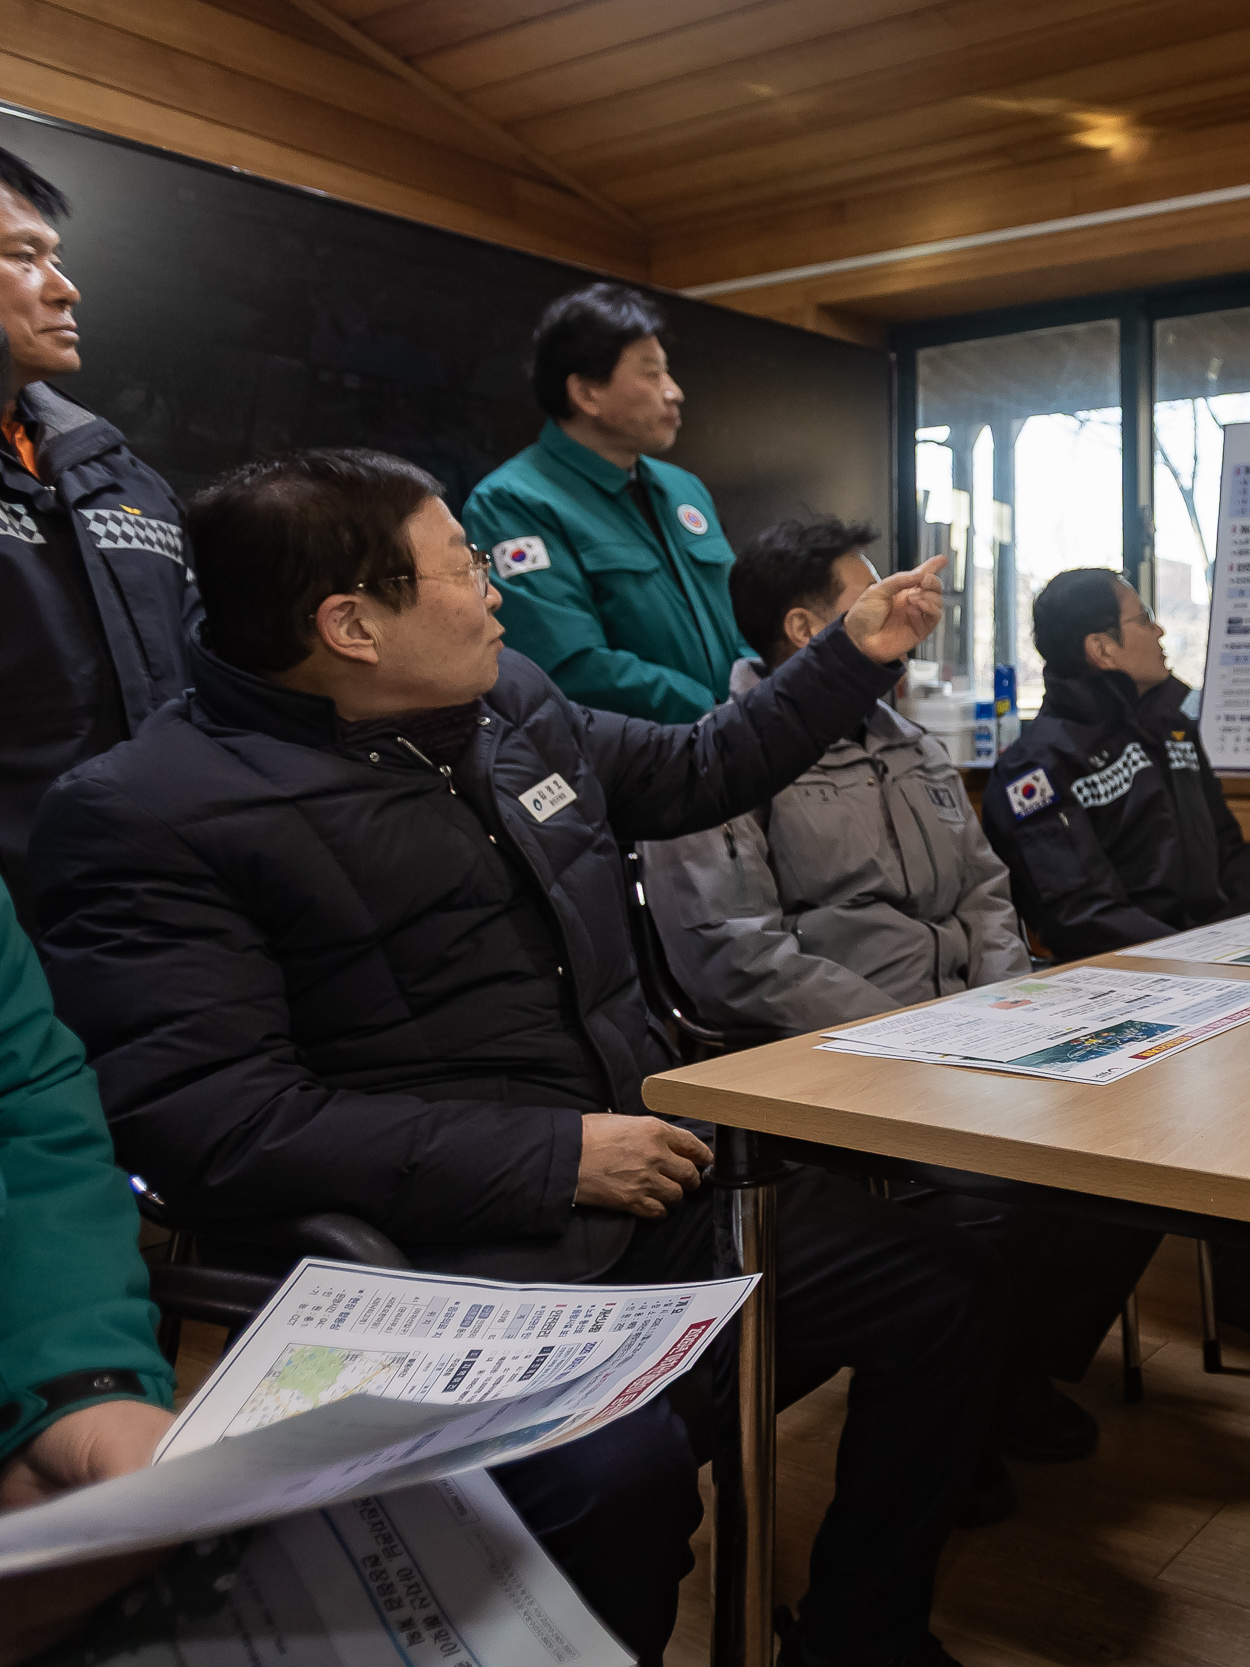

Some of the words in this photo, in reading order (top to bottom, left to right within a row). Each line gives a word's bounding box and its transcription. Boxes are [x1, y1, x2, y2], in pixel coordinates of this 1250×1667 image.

[323, 1293, 346, 1313] 운영시간
[436, 1306, 459, 1329] 응급의료
[524, 1309, 545, 1330] 안전관리
[572, 1319, 589, 1334] 등산로
[587, 1308, 613, 1332] 개선사항
[361, 1554, 402, 1612] 현장점검
[395, 1619, 424, 1648] 계획
[395, 1567, 432, 1610] 아차산
[422, 1614, 461, 1658] 해맞이
